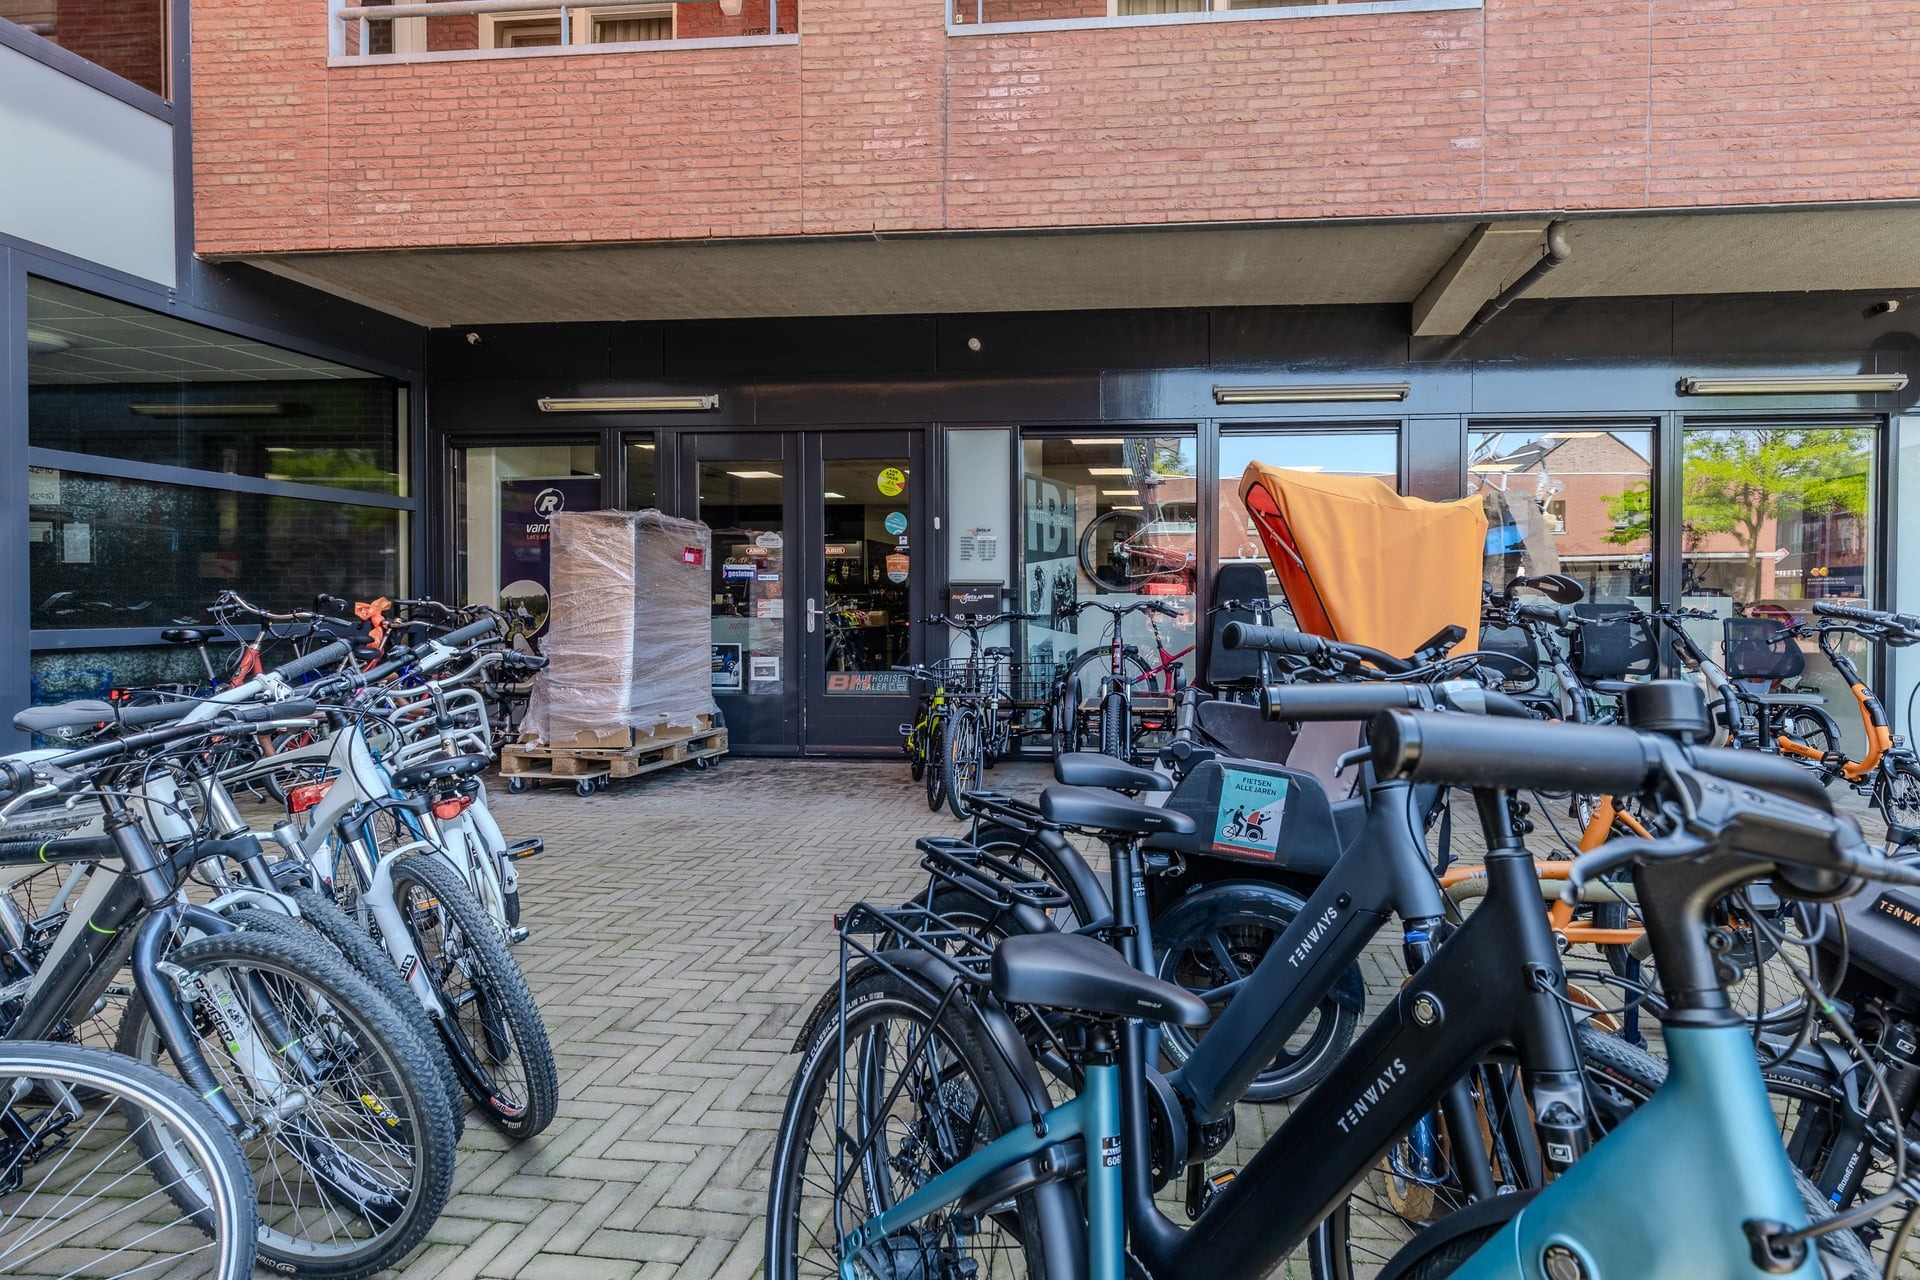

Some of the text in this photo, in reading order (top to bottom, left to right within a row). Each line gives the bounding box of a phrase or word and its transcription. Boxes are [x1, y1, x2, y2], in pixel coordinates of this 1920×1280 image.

[856, 674, 908, 683] AUTHORISED
[855, 683, 888, 691] DEALER
[1242, 777, 1273, 788] FIETSEN
[1235, 783, 1277, 796] ALLE JAREN
[1288, 906, 1338, 968] TENWAYS
[810, 1022, 832, 1057] CLASSIC
[859, 995, 868, 1003] XL
[1337, 1057, 1407, 1133] TENWAYS
